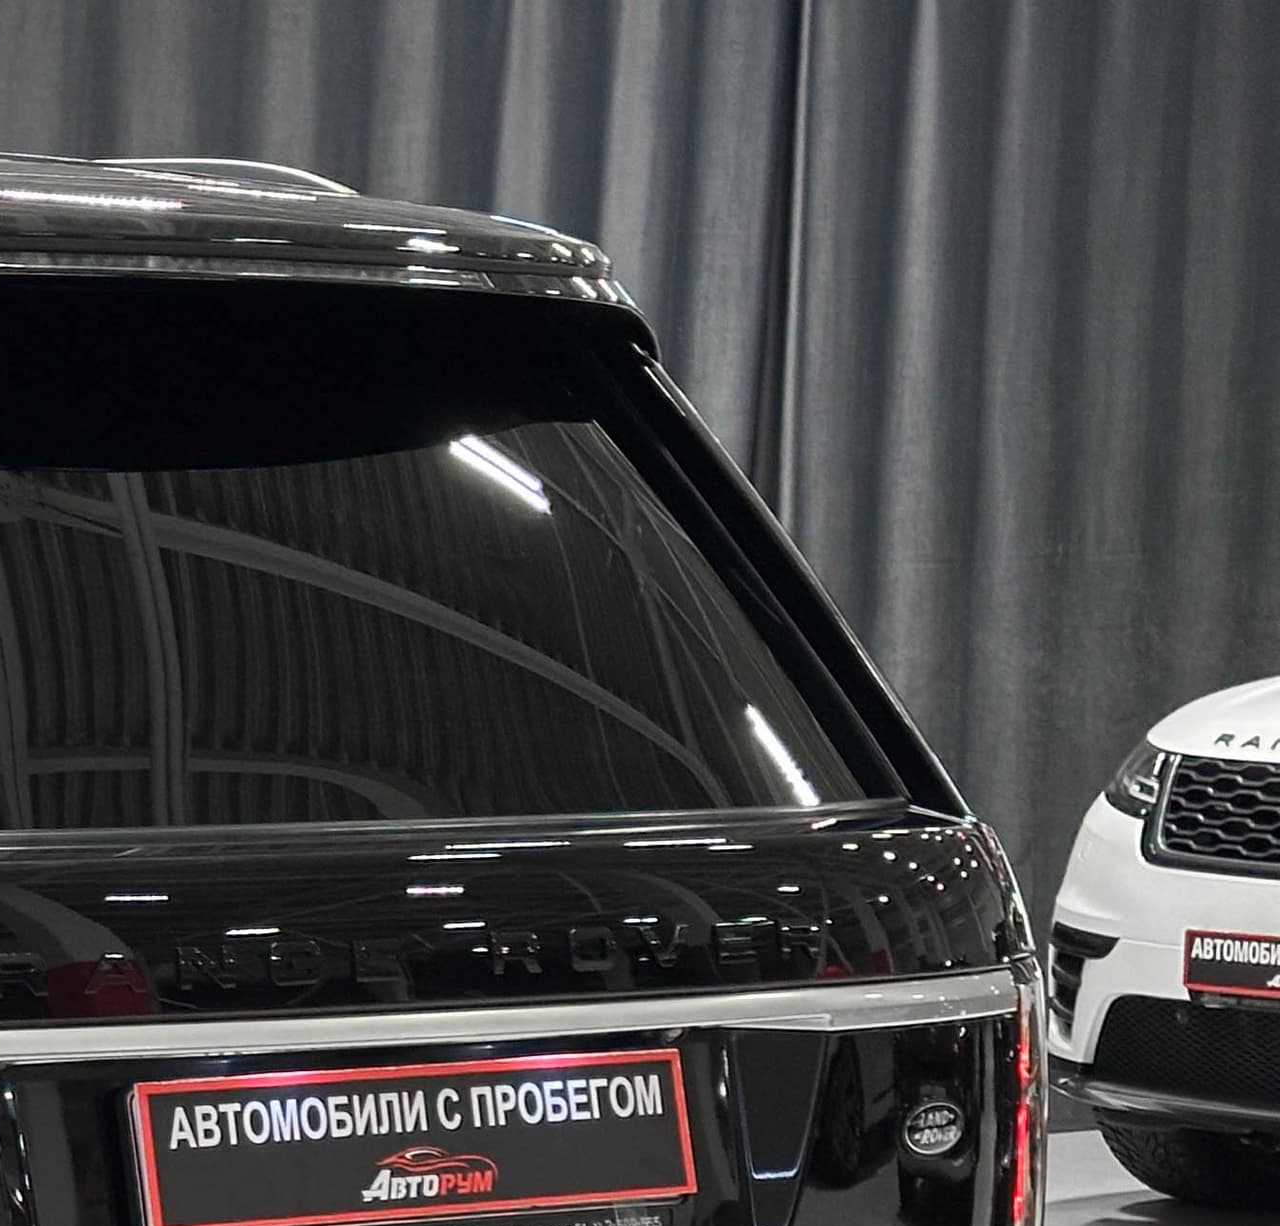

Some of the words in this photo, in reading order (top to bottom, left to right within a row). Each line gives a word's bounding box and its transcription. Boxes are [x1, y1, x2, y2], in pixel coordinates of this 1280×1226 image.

[169, 1090, 428, 1150] АВТОМОБИЛИ
[436, 1087, 462, 1130] С
[470, 1074, 664, 1128] ПРОБЕГОМ
